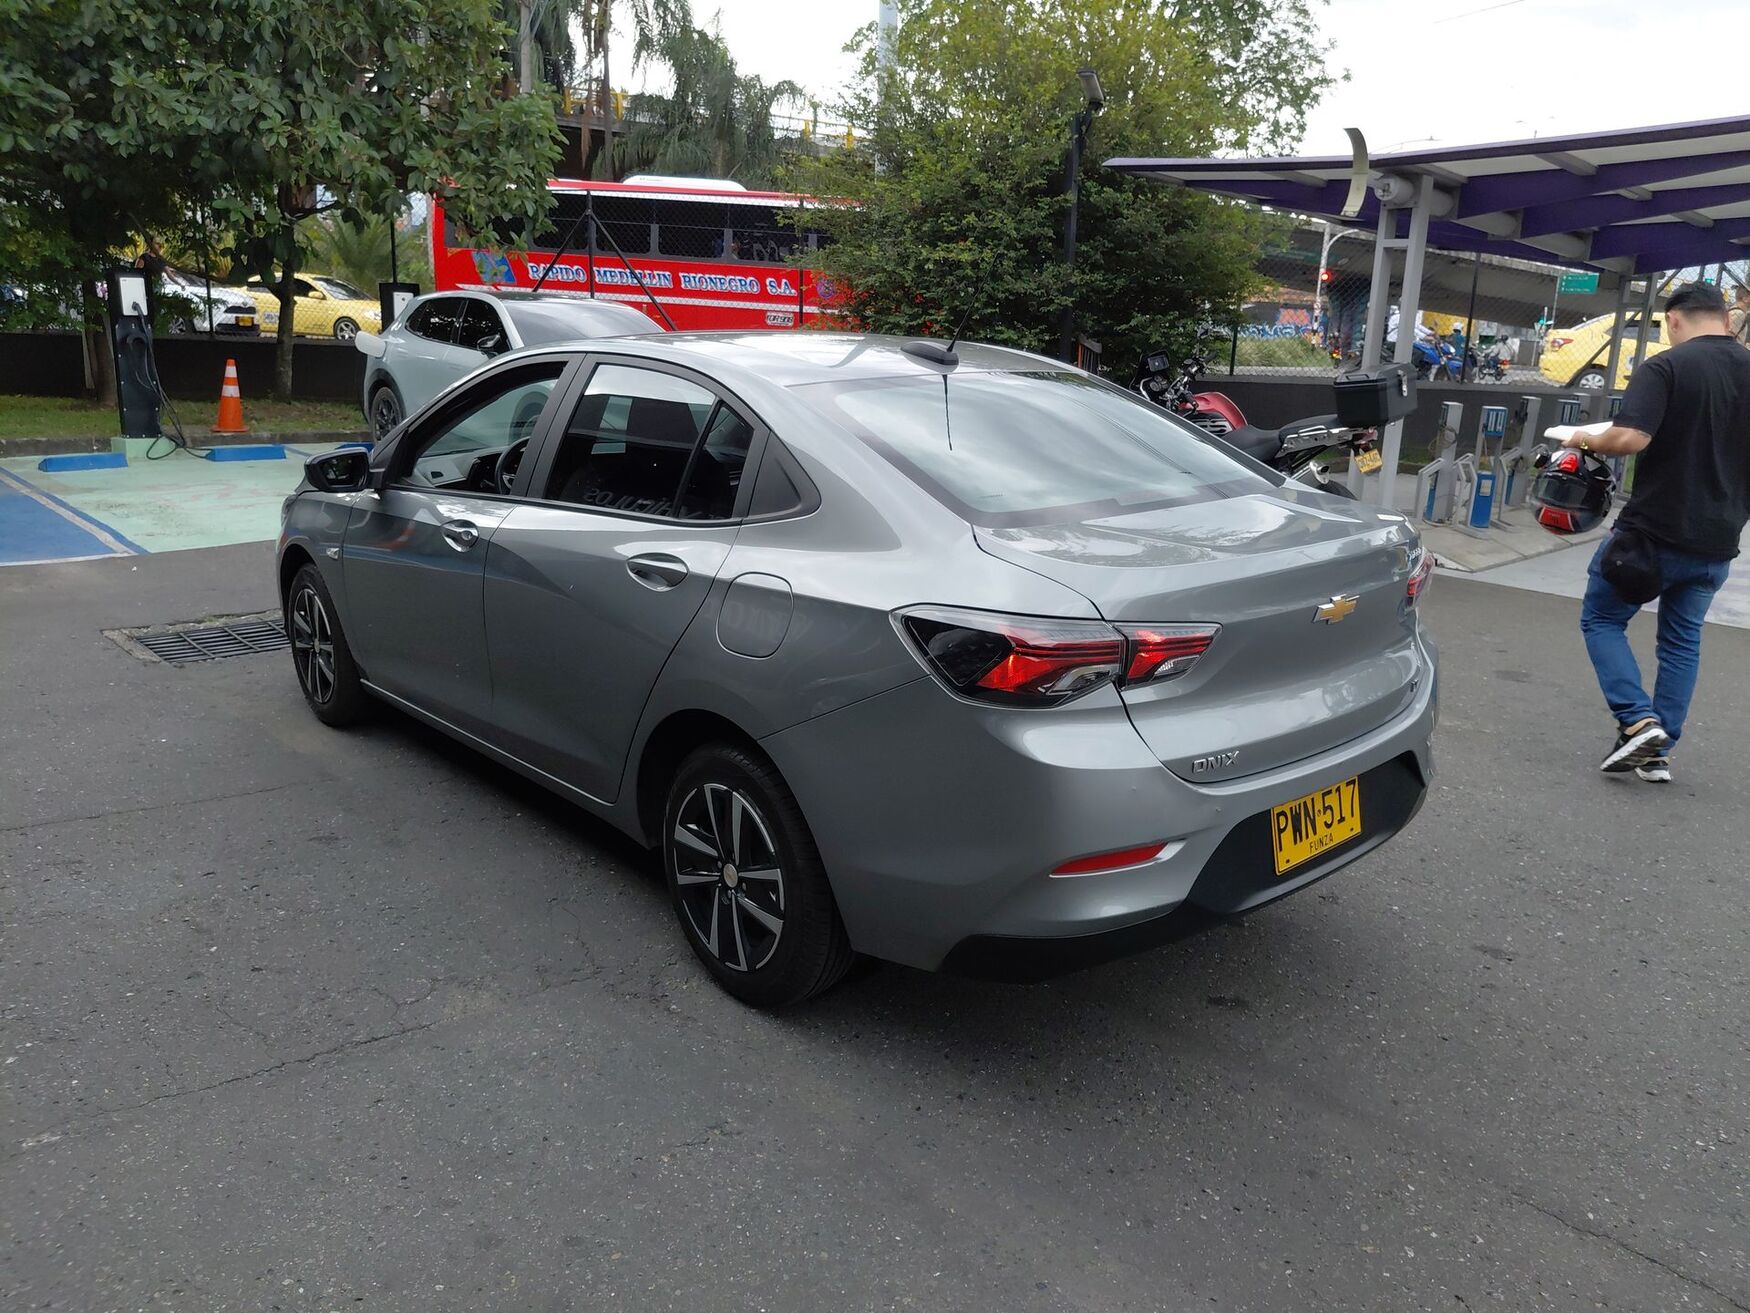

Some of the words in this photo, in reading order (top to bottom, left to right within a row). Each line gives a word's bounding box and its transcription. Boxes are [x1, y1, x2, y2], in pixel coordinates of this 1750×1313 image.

[594, 267, 673, 288] MEDELLIN
[679, 272, 760, 294] RIONEGRO
[766, 278, 798, 296] S.A.
[1191, 750, 1240, 774] ONIX
[1309, 832, 1334, 854] FUNZA
